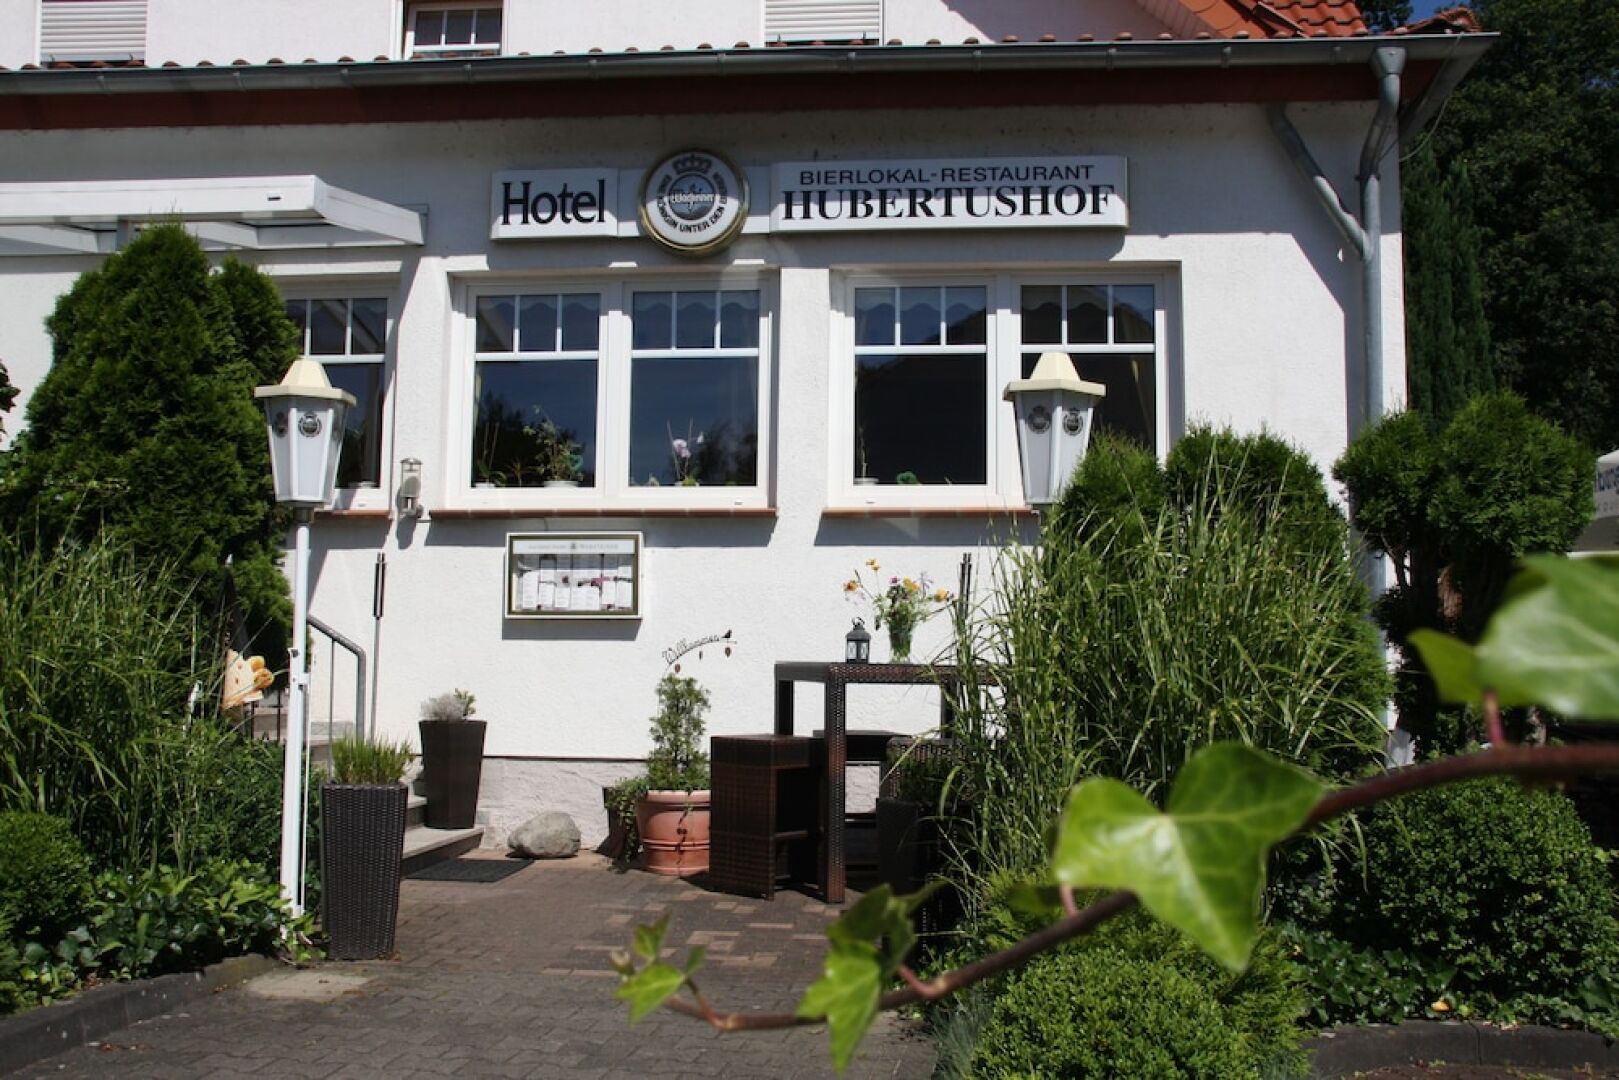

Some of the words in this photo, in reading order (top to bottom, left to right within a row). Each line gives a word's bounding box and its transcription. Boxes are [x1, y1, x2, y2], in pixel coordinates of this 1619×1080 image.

[800, 165, 1095, 186] BIERLOKAL-RESTAURANT
[501, 178, 606, 226] Hotel
[782, 184, 1115, 220] HUBERTUSHOF
